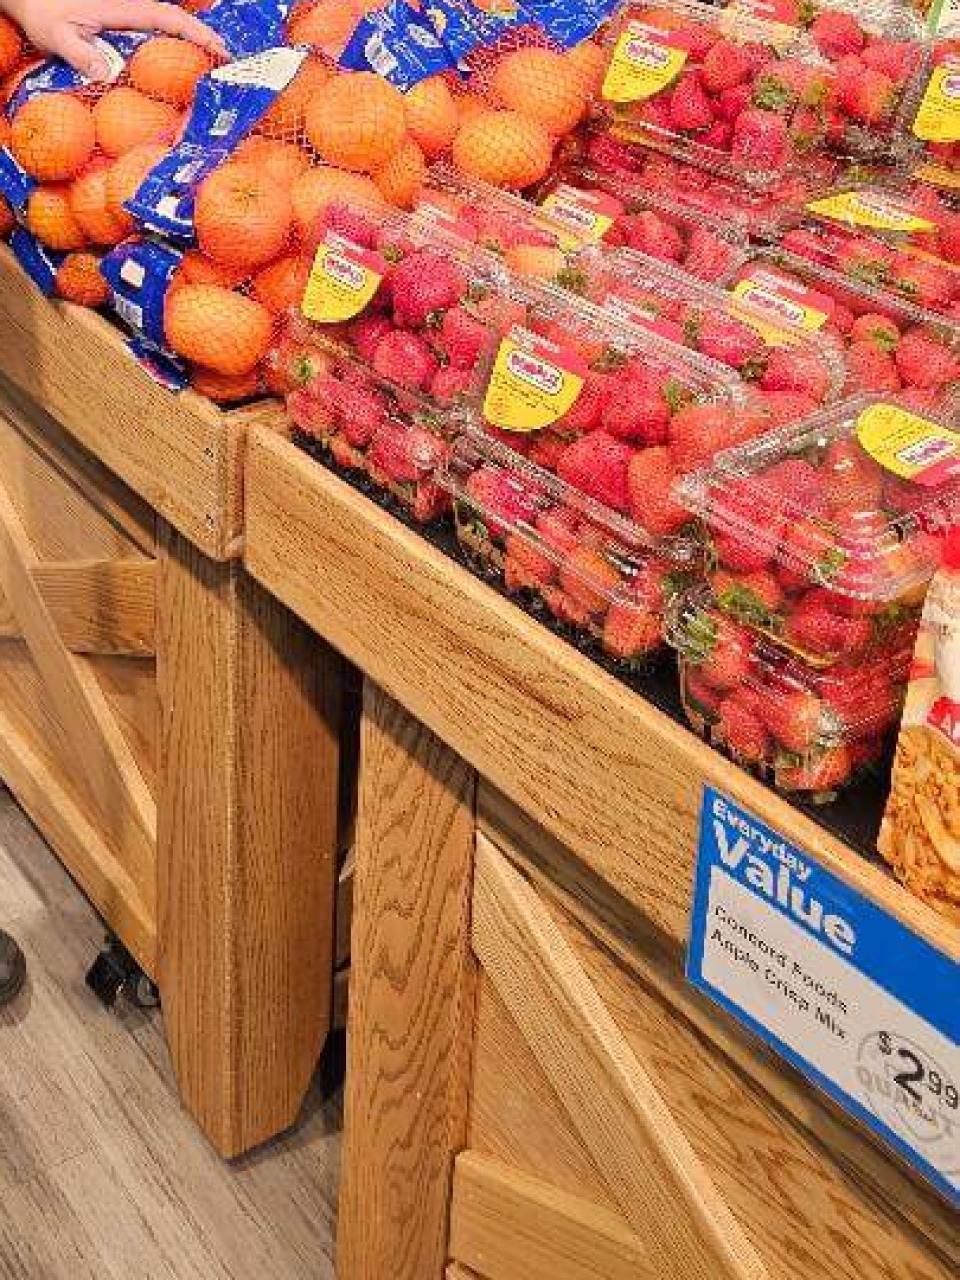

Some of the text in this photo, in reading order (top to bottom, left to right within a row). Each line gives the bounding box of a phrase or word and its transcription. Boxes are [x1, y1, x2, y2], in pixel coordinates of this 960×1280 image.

[712, 798, 812, 883] Everyday
[713, 821, 857, 956] Value
[711, 928, 846, 1039] Apple Crisp Mix
[715, 905, 847, 1014] Concord Foods
